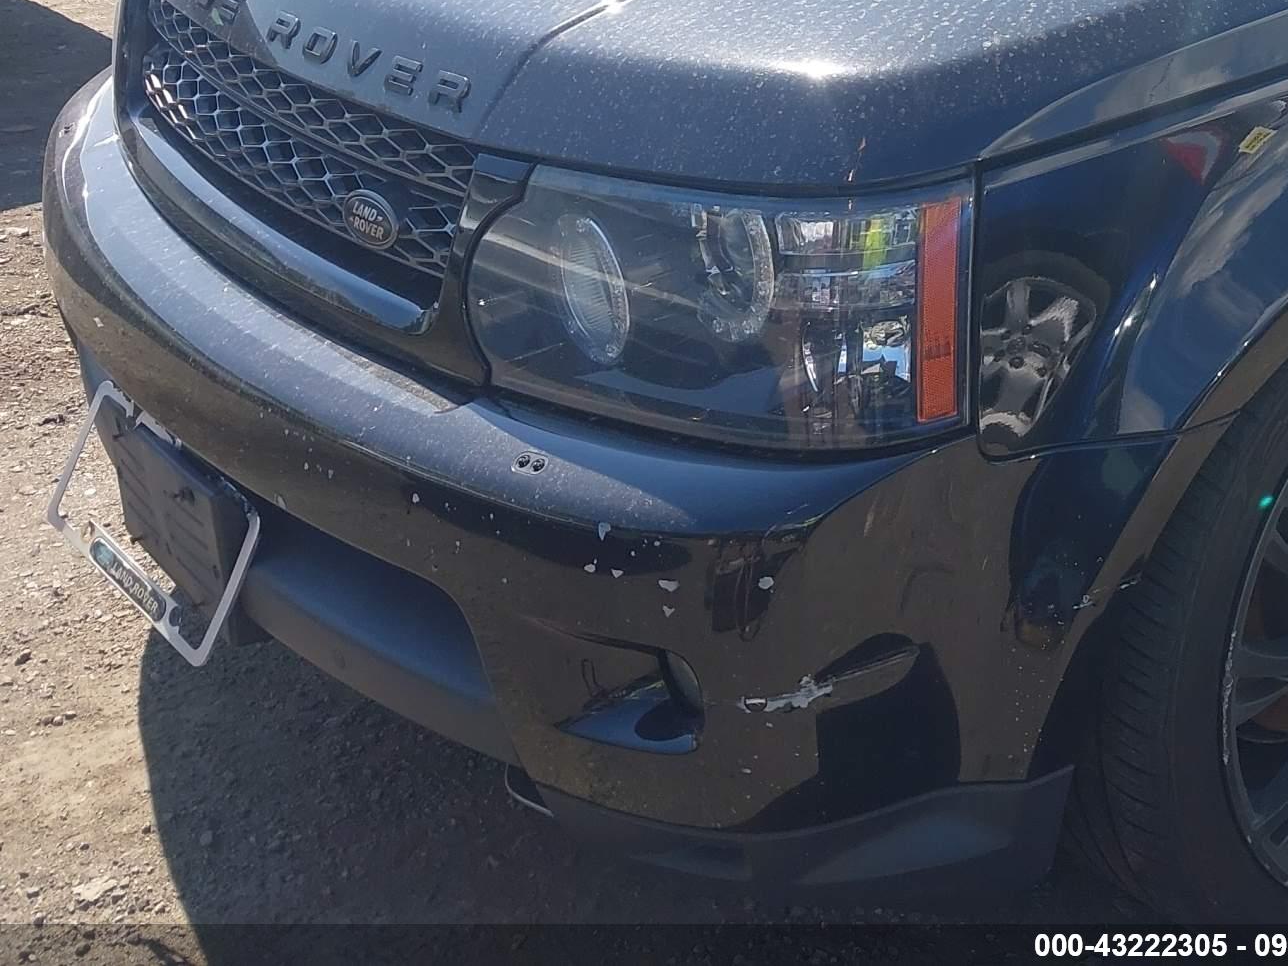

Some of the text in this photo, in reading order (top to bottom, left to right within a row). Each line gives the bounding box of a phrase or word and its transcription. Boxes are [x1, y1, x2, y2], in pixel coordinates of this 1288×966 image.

[265, 9, 474, 114] ROVER
[352, 201, 377, 222] LAND
[353, 216, 384, 240] ROVER
[110, 561, 159, 614] LAND ROVER
